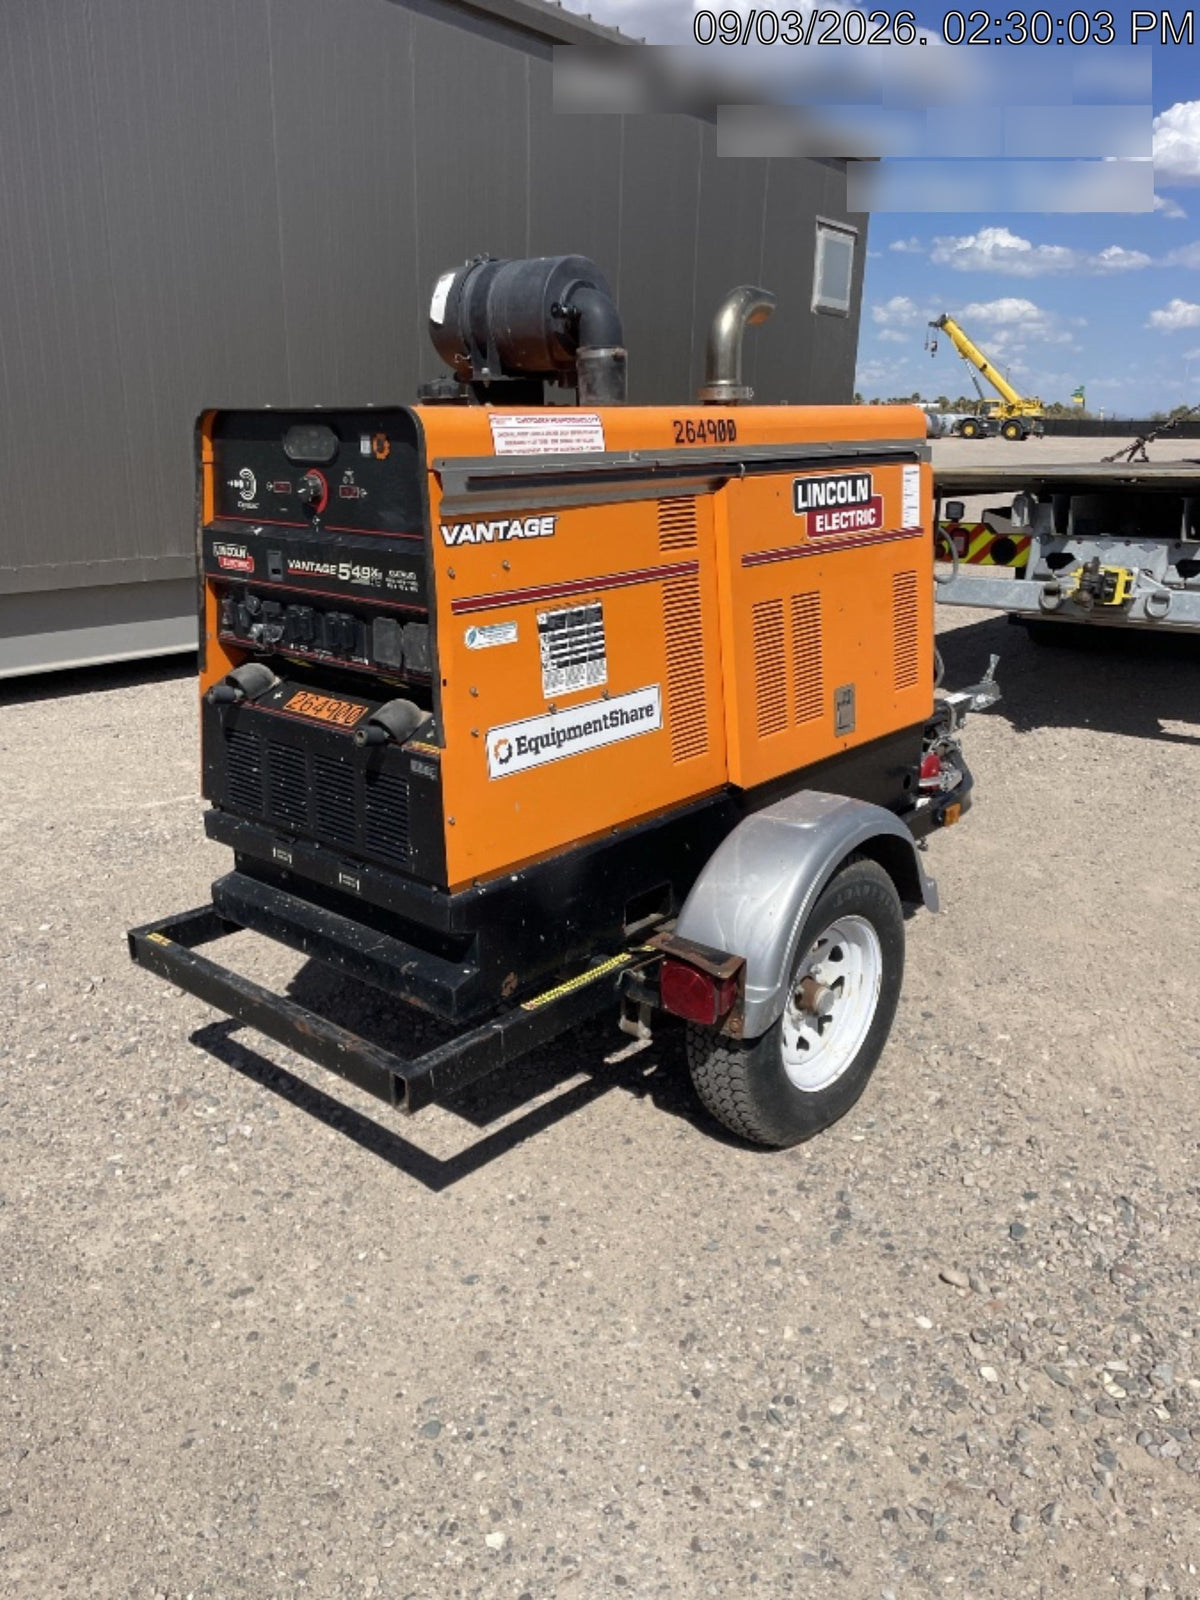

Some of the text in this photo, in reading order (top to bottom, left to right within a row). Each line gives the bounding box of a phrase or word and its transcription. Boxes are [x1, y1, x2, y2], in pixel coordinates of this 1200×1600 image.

[673, 418, 737, 444] 264900
[797, 478, 869, 509] LINCOLN
[440, 516, 555, 546] VANTAGE
[815, 508, 876, 533] ELECTRIC
[287, 559, 338, 575] VANTAGE
[285, 691, 364, 725] 264900
[515, 703, 655, 756] EquipmentShare
